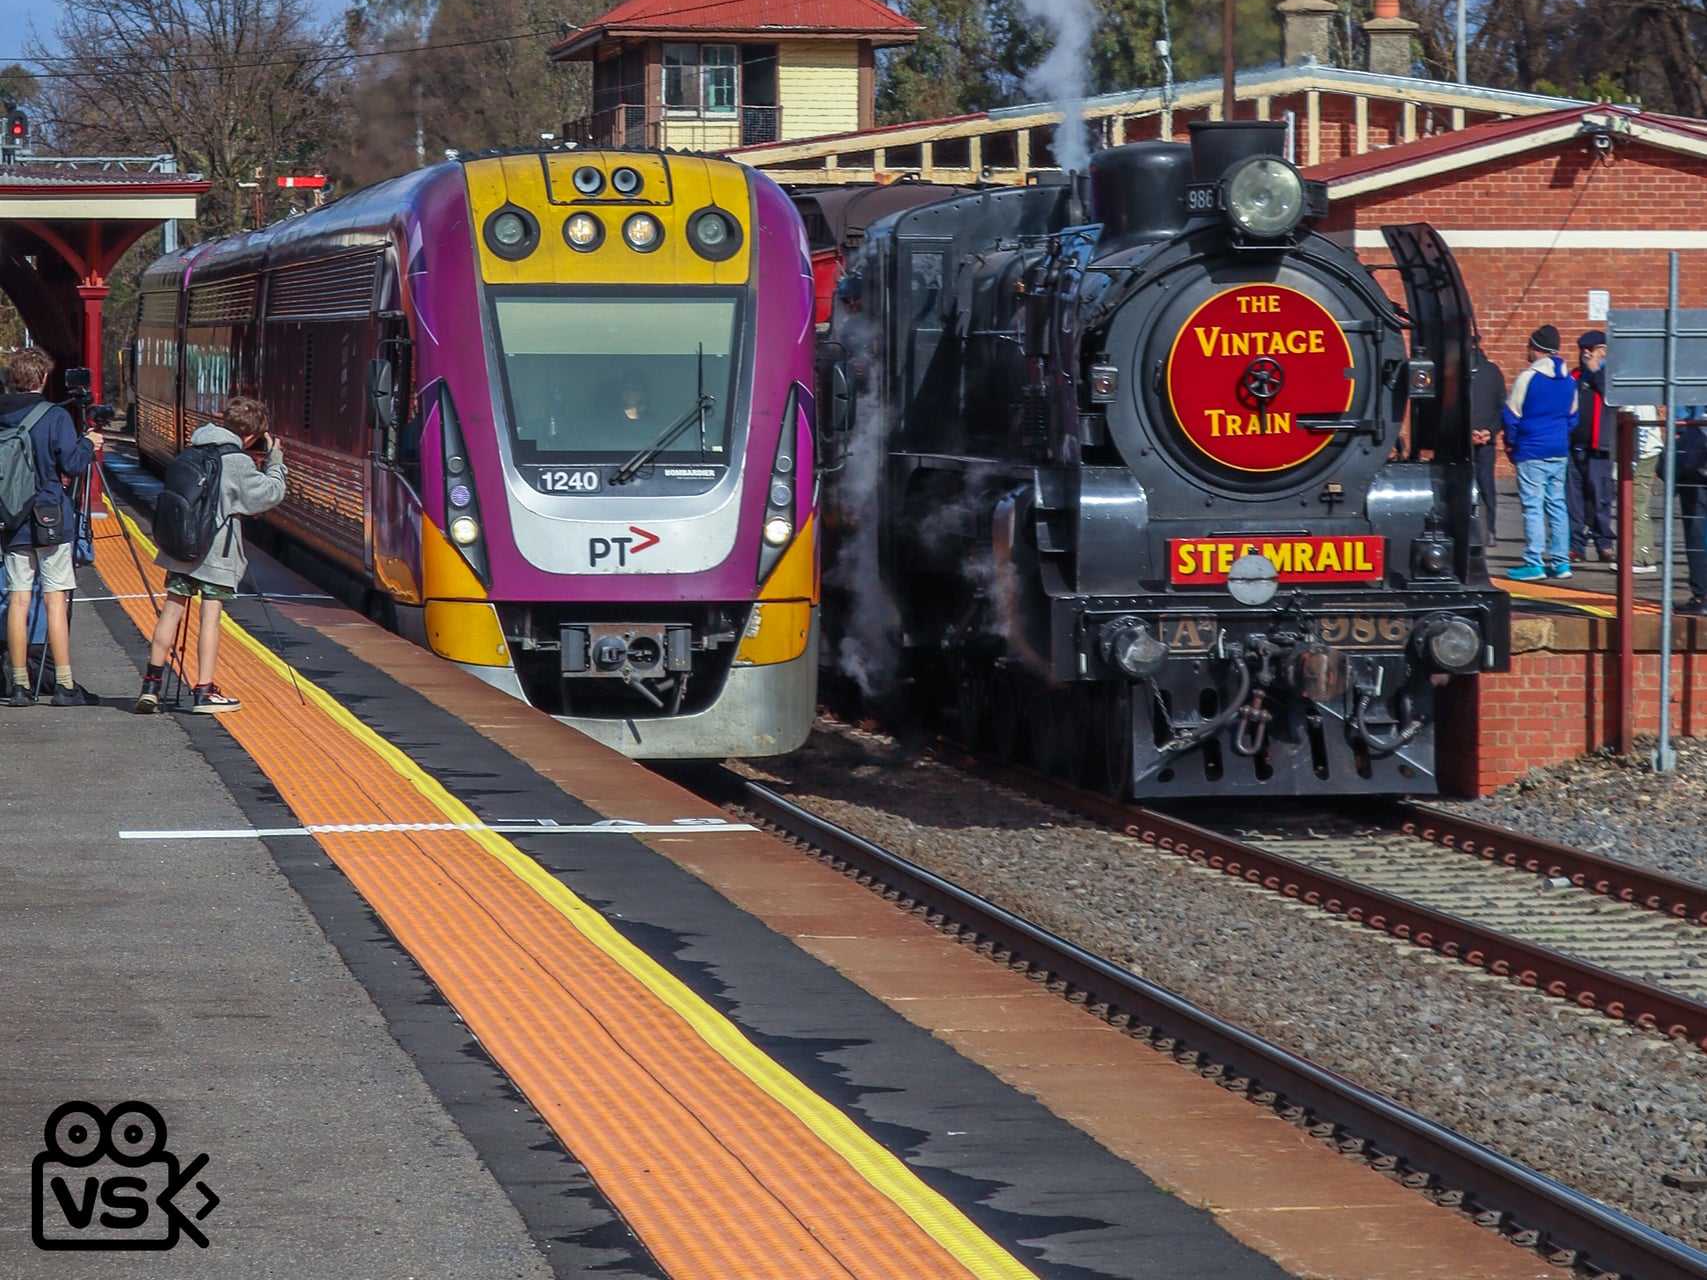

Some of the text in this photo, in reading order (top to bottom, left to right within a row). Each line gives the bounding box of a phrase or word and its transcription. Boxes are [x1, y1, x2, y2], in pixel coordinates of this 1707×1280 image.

[1189, 190, 1213, 208] 986
[1236, 295, 1281, 313] THE
[1194, 326, 1326, 357] VINTAGE
[541, 471, 599, 491] 1240
[1320, 614, 1409, 642] 986
